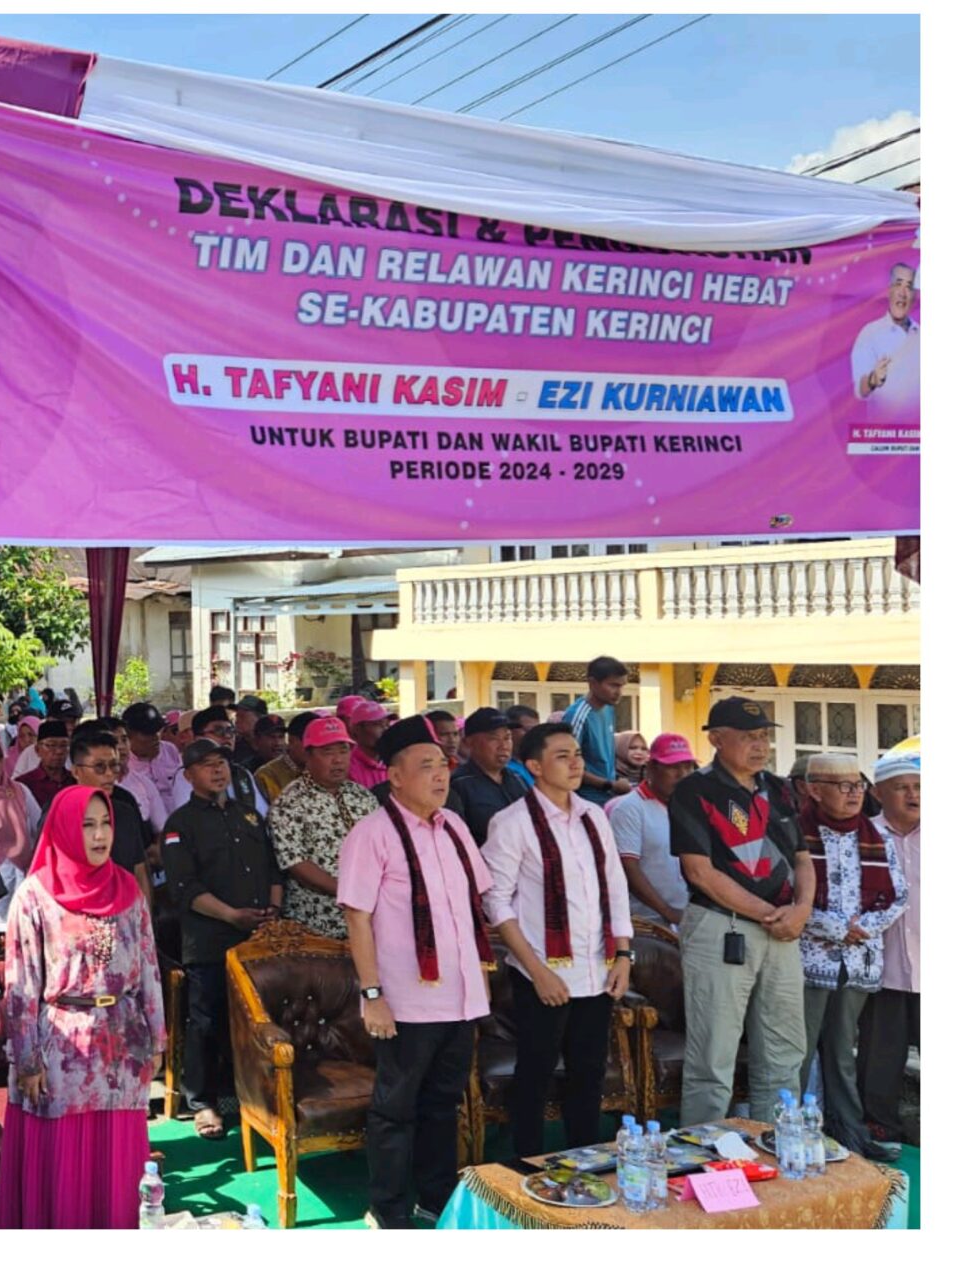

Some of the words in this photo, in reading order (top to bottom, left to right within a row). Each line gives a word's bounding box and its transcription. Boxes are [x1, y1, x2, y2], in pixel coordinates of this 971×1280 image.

[173, 177, 460, 238] DEKLARASI
[192, 233, 269, 272] TIM
[282, 241, 366, 278] DAN
[377, 248, 553, 291] RELAWAN
[561, 260, 694, 301] KERINCI
[701, 272, 794, 307] HEBAT
[296, 290, 576, 338] SE-KABUPATEN
[584, 308, 714, 345] KERINCI
[172, 363, 212, 396] H.
[224, 366, 382, 403] TAFYANI
[392, 374, 508, 408] KASIM
[537, 379, 594, 410] EZI
[601, 382, 785, 413] KURNIAWAN
[250, 425, 336, 448] UNTUK
[344, 428, 429, 450] BUPATI
[437, 431, 484, 451] DAN
[491, 433, 561, 453] WAKIL
[570, 434, 647, 453] BUPATI
[654, 434, 743, 453] KERINCI
[389, 459, 492, 480] PERIODE
[499, 462, 552, 480] 2024
[574, 462, 625, 481] 2029
